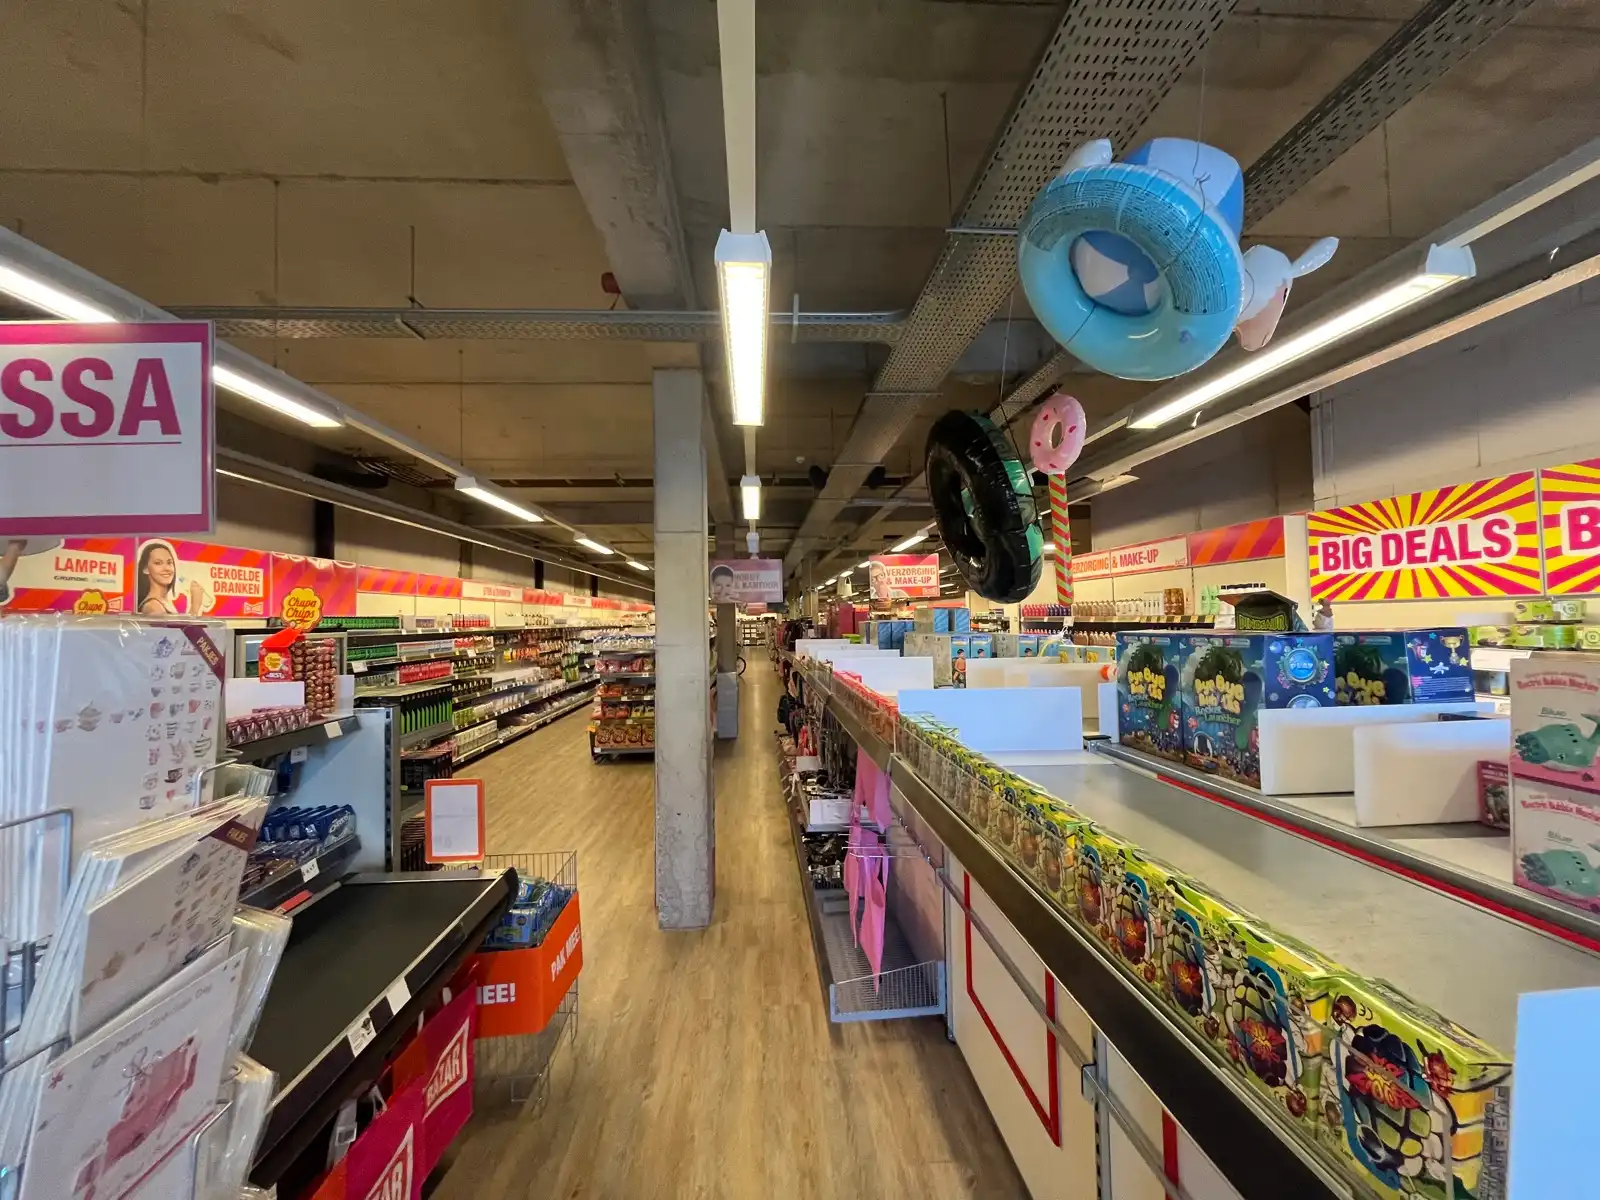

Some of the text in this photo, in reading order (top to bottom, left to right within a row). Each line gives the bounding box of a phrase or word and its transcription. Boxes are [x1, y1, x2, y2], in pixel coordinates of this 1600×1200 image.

[0, 357, 182, 439] SSA
[1322, 518, 1513, 572] BIG DEALS
[54, 556, 117, 576] LAMPEN
[1073, 557, 1109, 573] ERZORGING
[1112, 556, 1118, 568] &
[1120, 549, 1159, 567] MAKE-UP
[210, 566, 261, 582] GEKOELDE
[886, 567, 935, 576] VERZORGING
[213, 581, 260, 595] DRANKEN
[886, 576, 932, 585] & MAKE-UP
[78, 600, 103, 612] Chupa
[288, 597, 317, 609] Chupa
[285, 607, 316, 619] Chups
[1238, 614, 1287, 631] DINOSAUR
[550, 922, 581, 982] PAK MEE!
[426, 1040, 461, 1107] BAZAR
